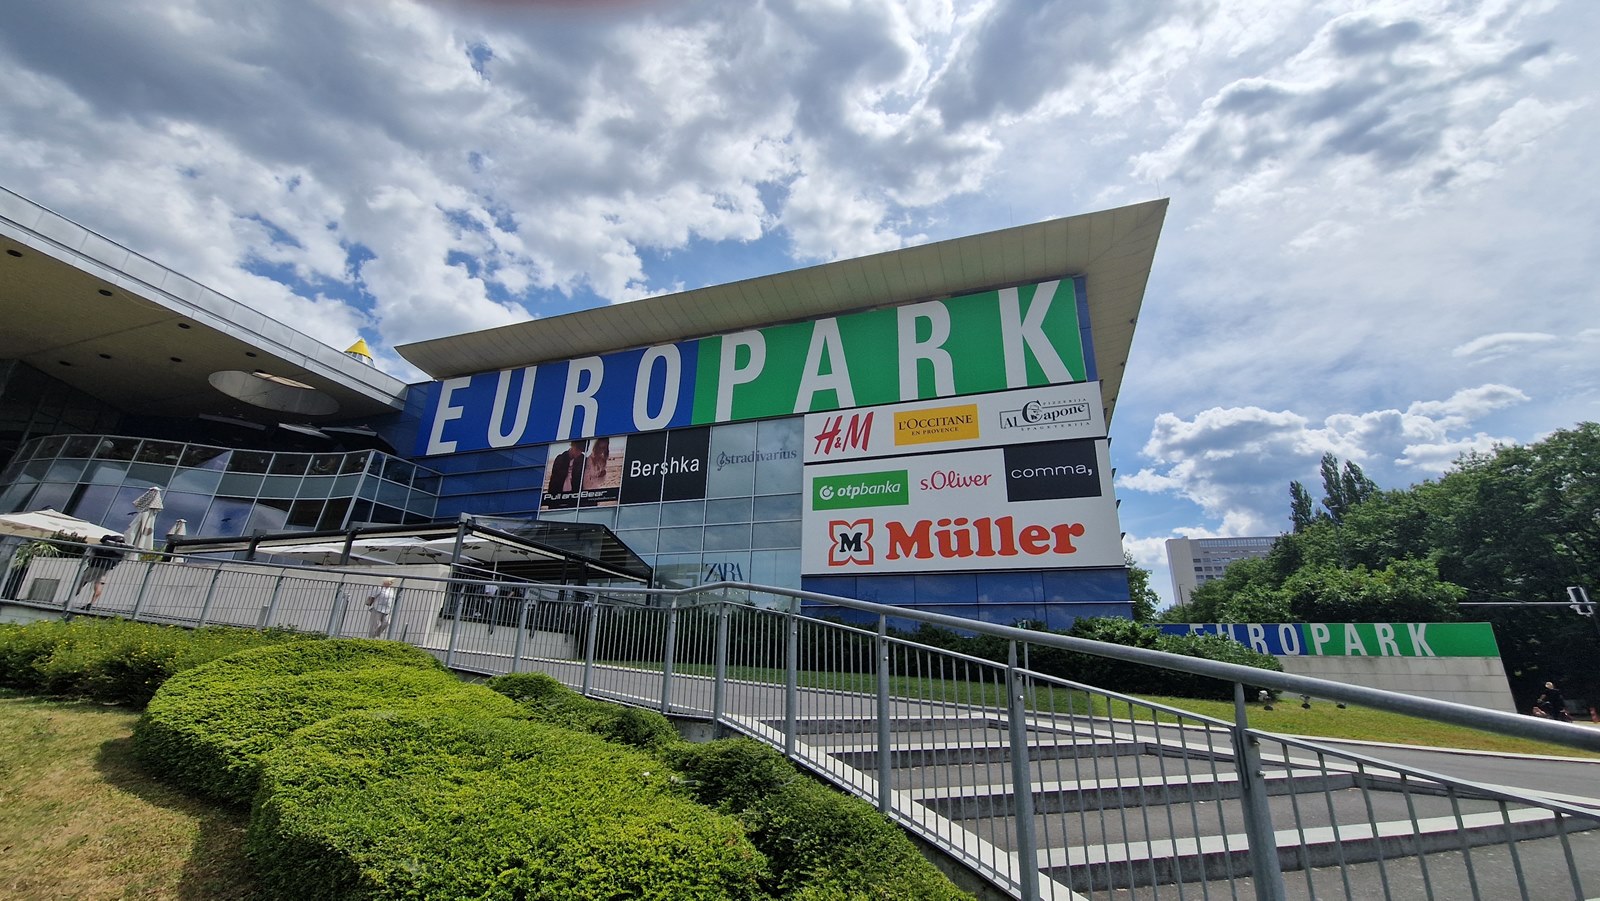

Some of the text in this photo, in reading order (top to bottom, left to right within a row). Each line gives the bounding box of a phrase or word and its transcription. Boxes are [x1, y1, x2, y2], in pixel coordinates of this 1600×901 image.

[426, 279, 1074, 456] EUROPARK
[898, 414, 973, 431] L'OCCITANE
[1004, 400, 1086, 428] Al Capone
[814, 411, 875, 455] H&M
[922, 427, 960, 435] PROVENCE
[630, 455, 700, 478] Bershka
[725, 448, 797, 465] stradivarius
[920, 470, 992, 491] s.Oliver
[1011, 462, 1093, 479] comma,
[543, 493, 561, 501] Pull
[562, 492, 579, 500] and
[580, 490, 607, 498] Bear
[837, 479, 901, 500] otpbanka
[838, 532, 863, 553] M
[885, 515, 1085, 560] Müller
[704, 562, 744, 582] ZARA
